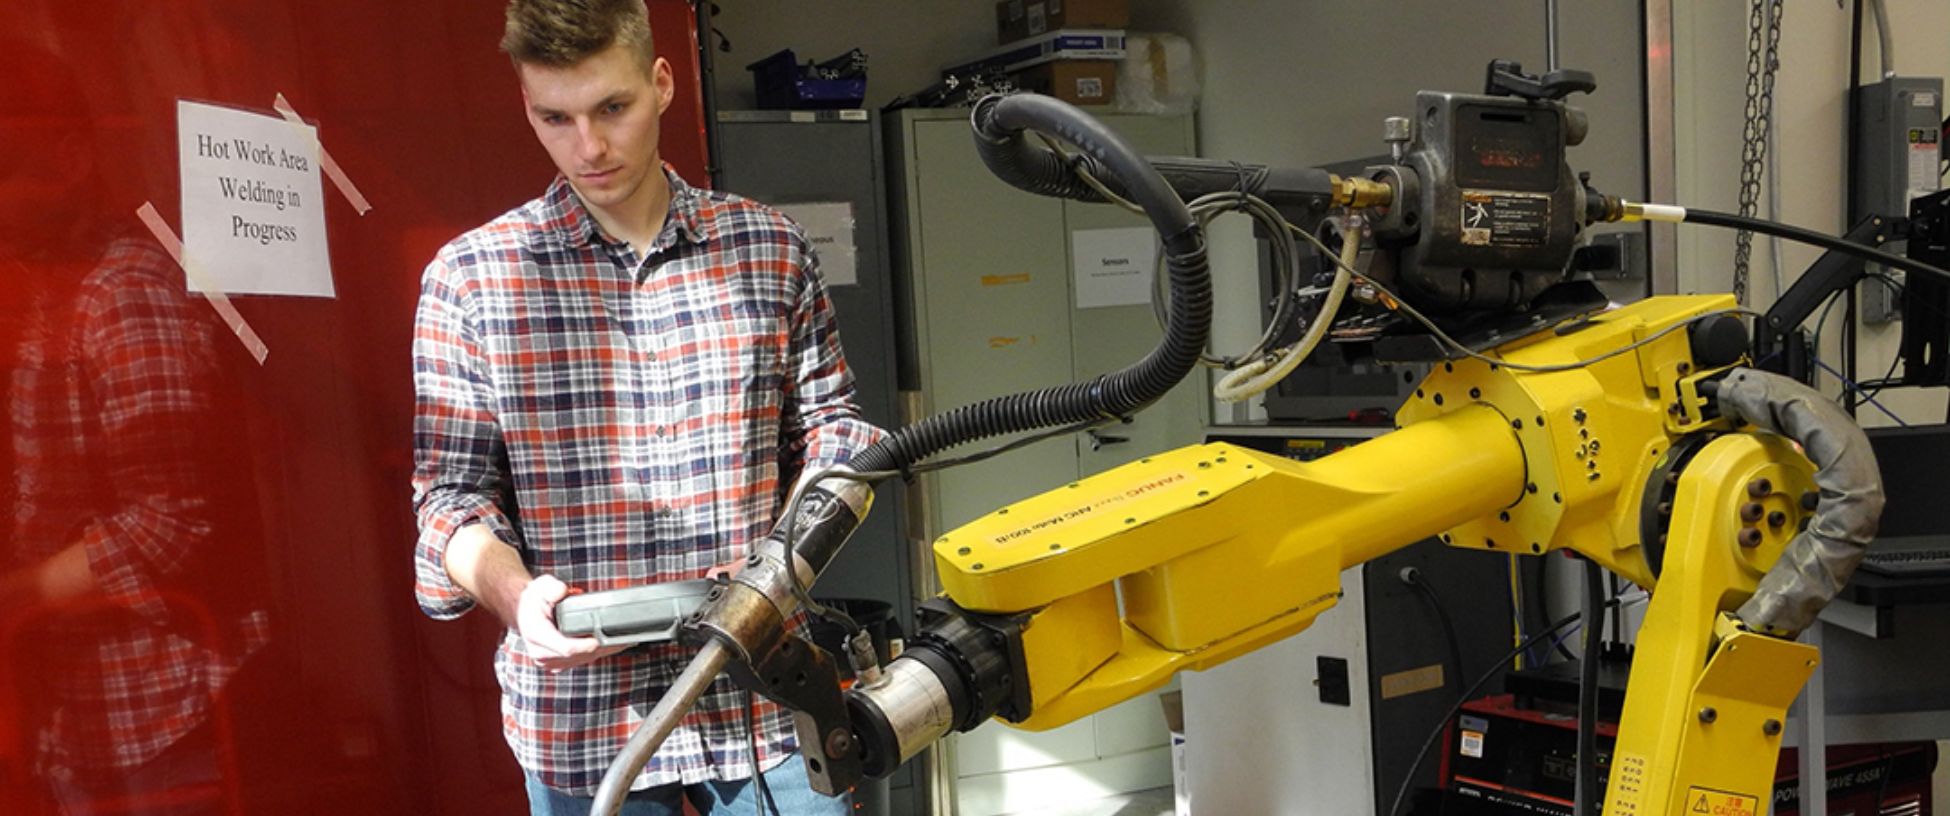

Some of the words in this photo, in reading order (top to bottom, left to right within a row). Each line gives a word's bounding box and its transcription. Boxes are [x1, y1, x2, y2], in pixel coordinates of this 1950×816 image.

[198, 134, 230, 160] Hot
[234, 139, 275, 167] Work
[279, 149, 309, 172] Area
[219, 176, 285, 210] Welding
[287, 185, 301, 207] in
[231, 215, 297, 245] Progress
[1126, 474, 1185, 497] FANUC
